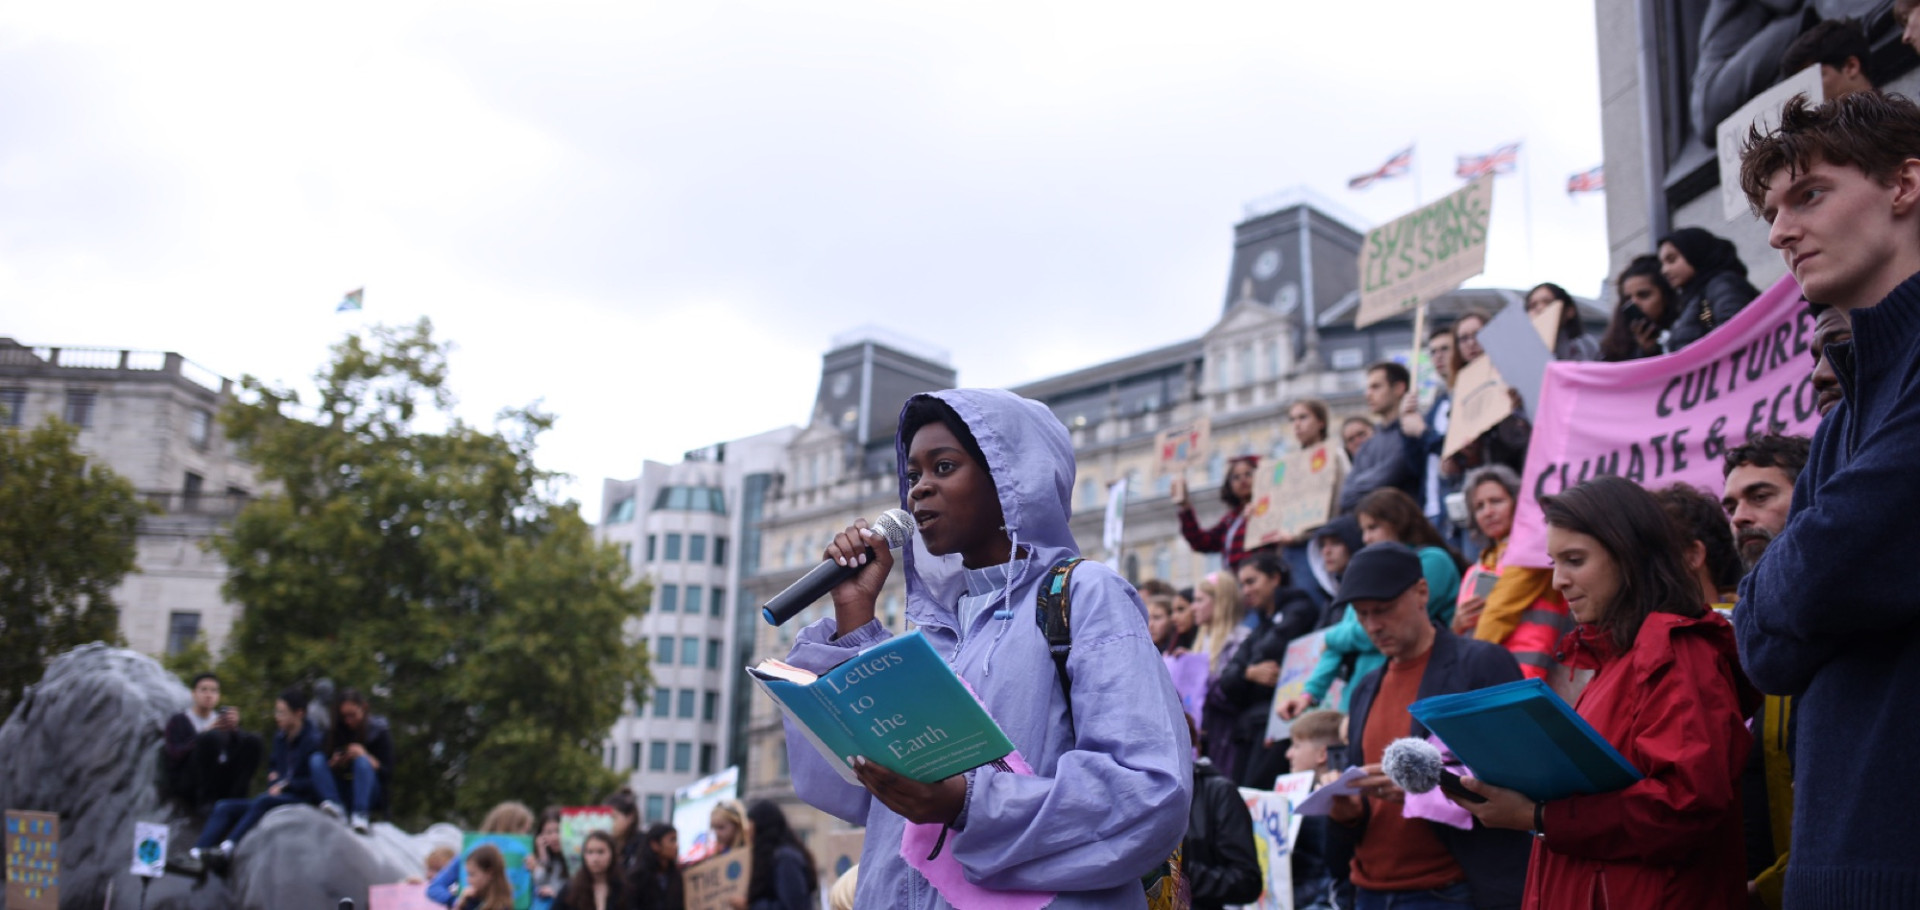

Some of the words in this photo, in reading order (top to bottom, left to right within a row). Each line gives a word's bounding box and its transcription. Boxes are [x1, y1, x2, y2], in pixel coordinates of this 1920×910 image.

[1365, 210, 1487, 292] LESSONS
[1656, 305, 1811, 418] CULTURE
[1534, 427, 1691, 499] CLIMATE
[1703, 416, 1727, 461] &
[826, 650, 903, 695] Letters
[849, 694, 875, 714] to
[870, 711, 907, 738] the
[888, 725, 948, 759] Earth
